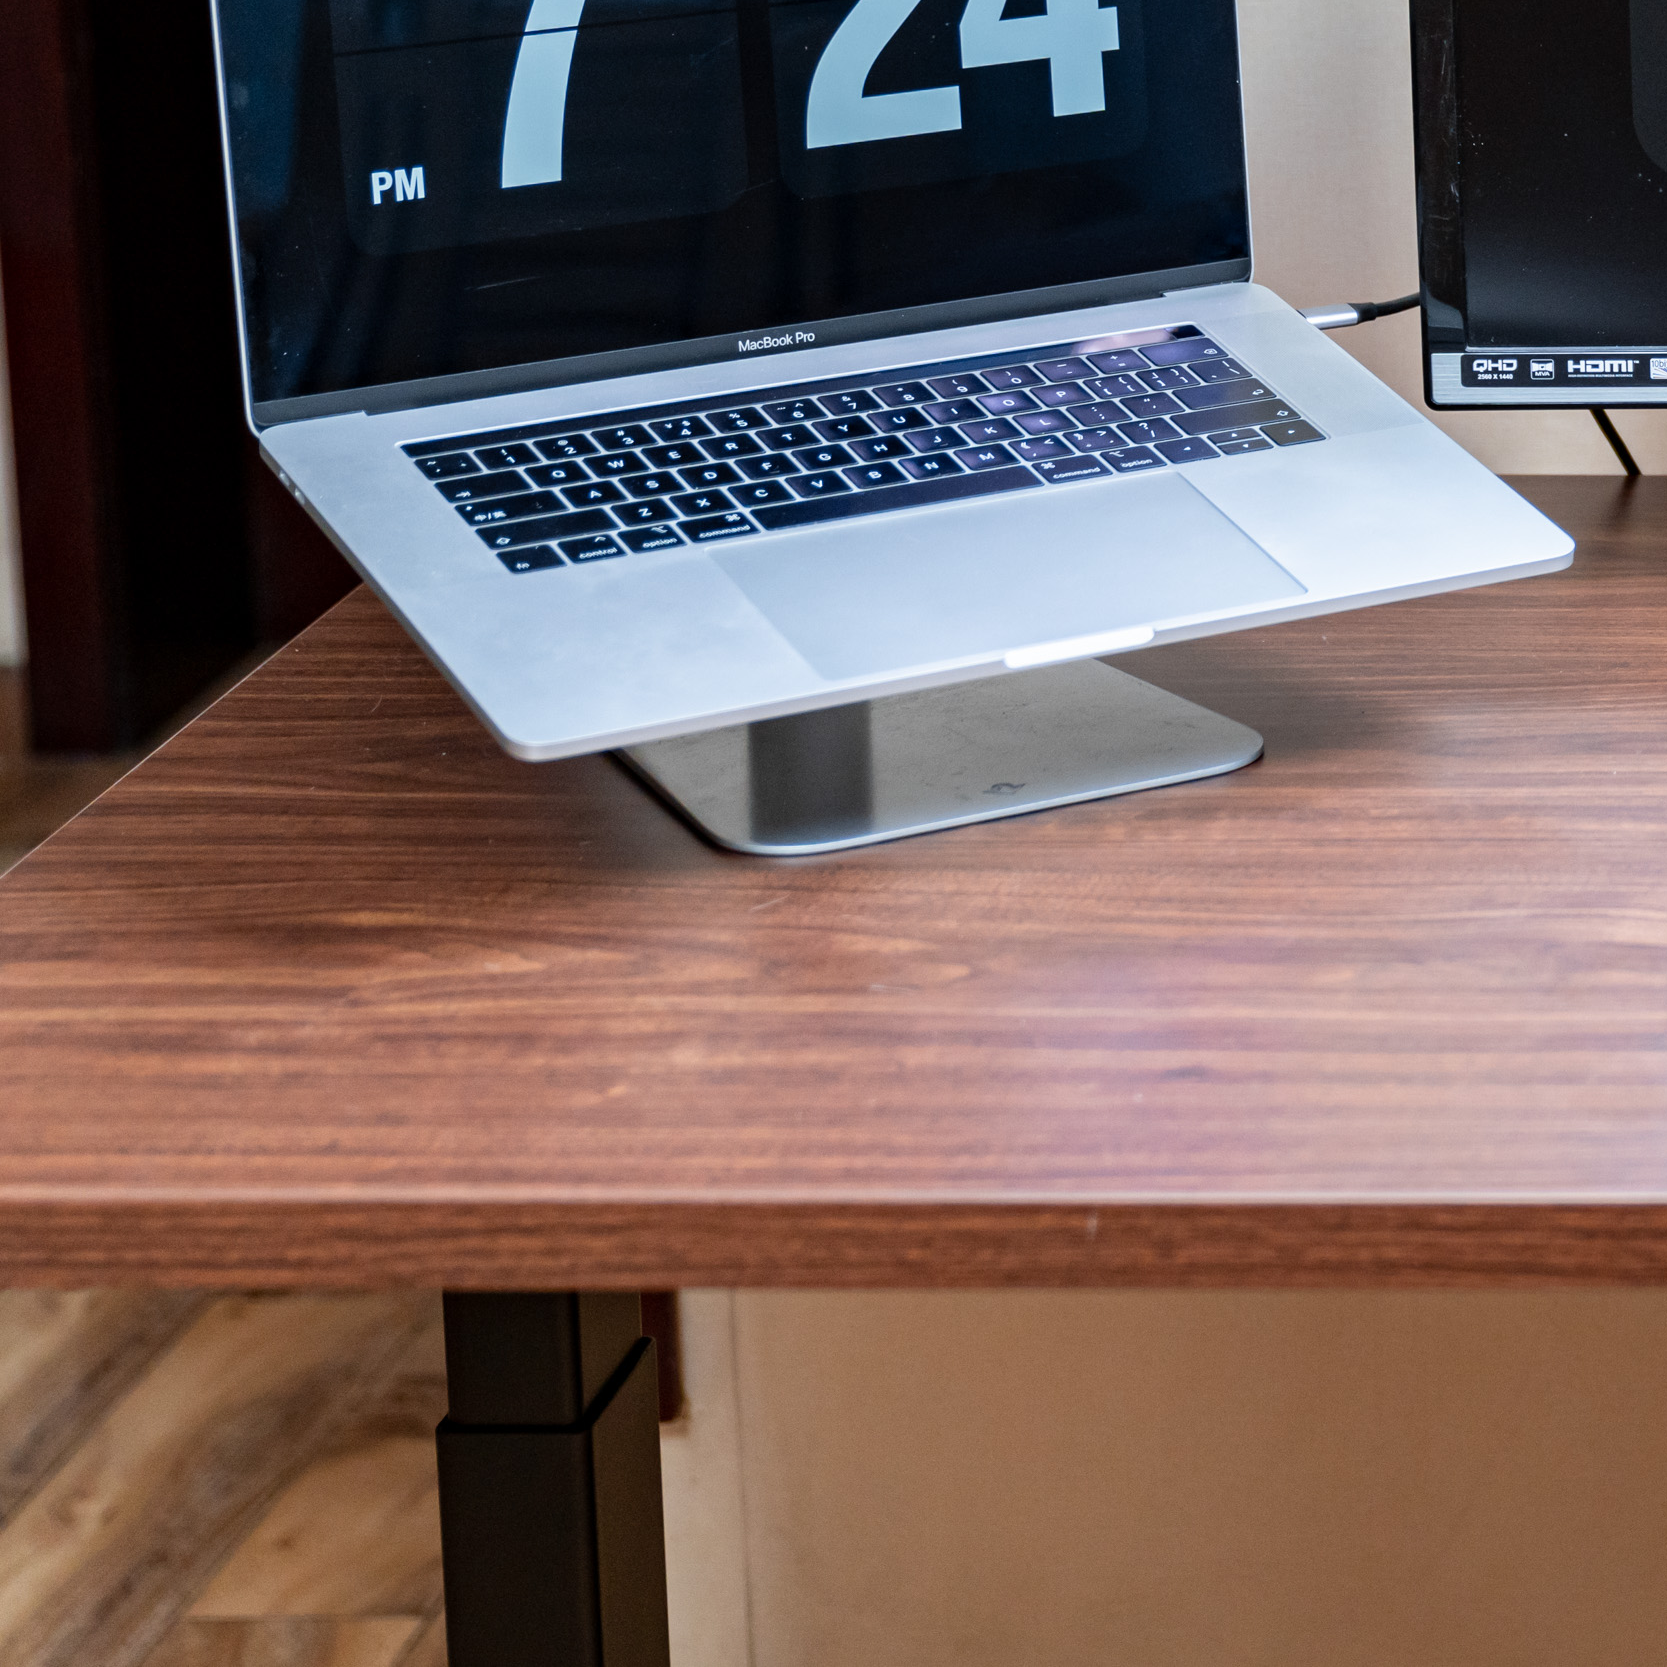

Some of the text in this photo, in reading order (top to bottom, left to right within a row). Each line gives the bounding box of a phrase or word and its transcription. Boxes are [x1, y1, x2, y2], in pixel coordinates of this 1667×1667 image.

[372, 167, 425, 204] PM
[738, 331, 816, 352] MacBook Pro
[1473, 359, 1518, 372] QHD
[1567, 360, 1634, 372] HDMI
[874, 444, 887, 452] H
[608, 460, 623, 468] W
[1121, 459, 1152, 467] option
[1053, 467, 1101, 479] command
[697, 499, 710, 507] X
[639, 508, 652, 516] Z
[699, 525, 751, 538] command
[642, 536, 677, 548] option
[579, 547, 618, 559] control
